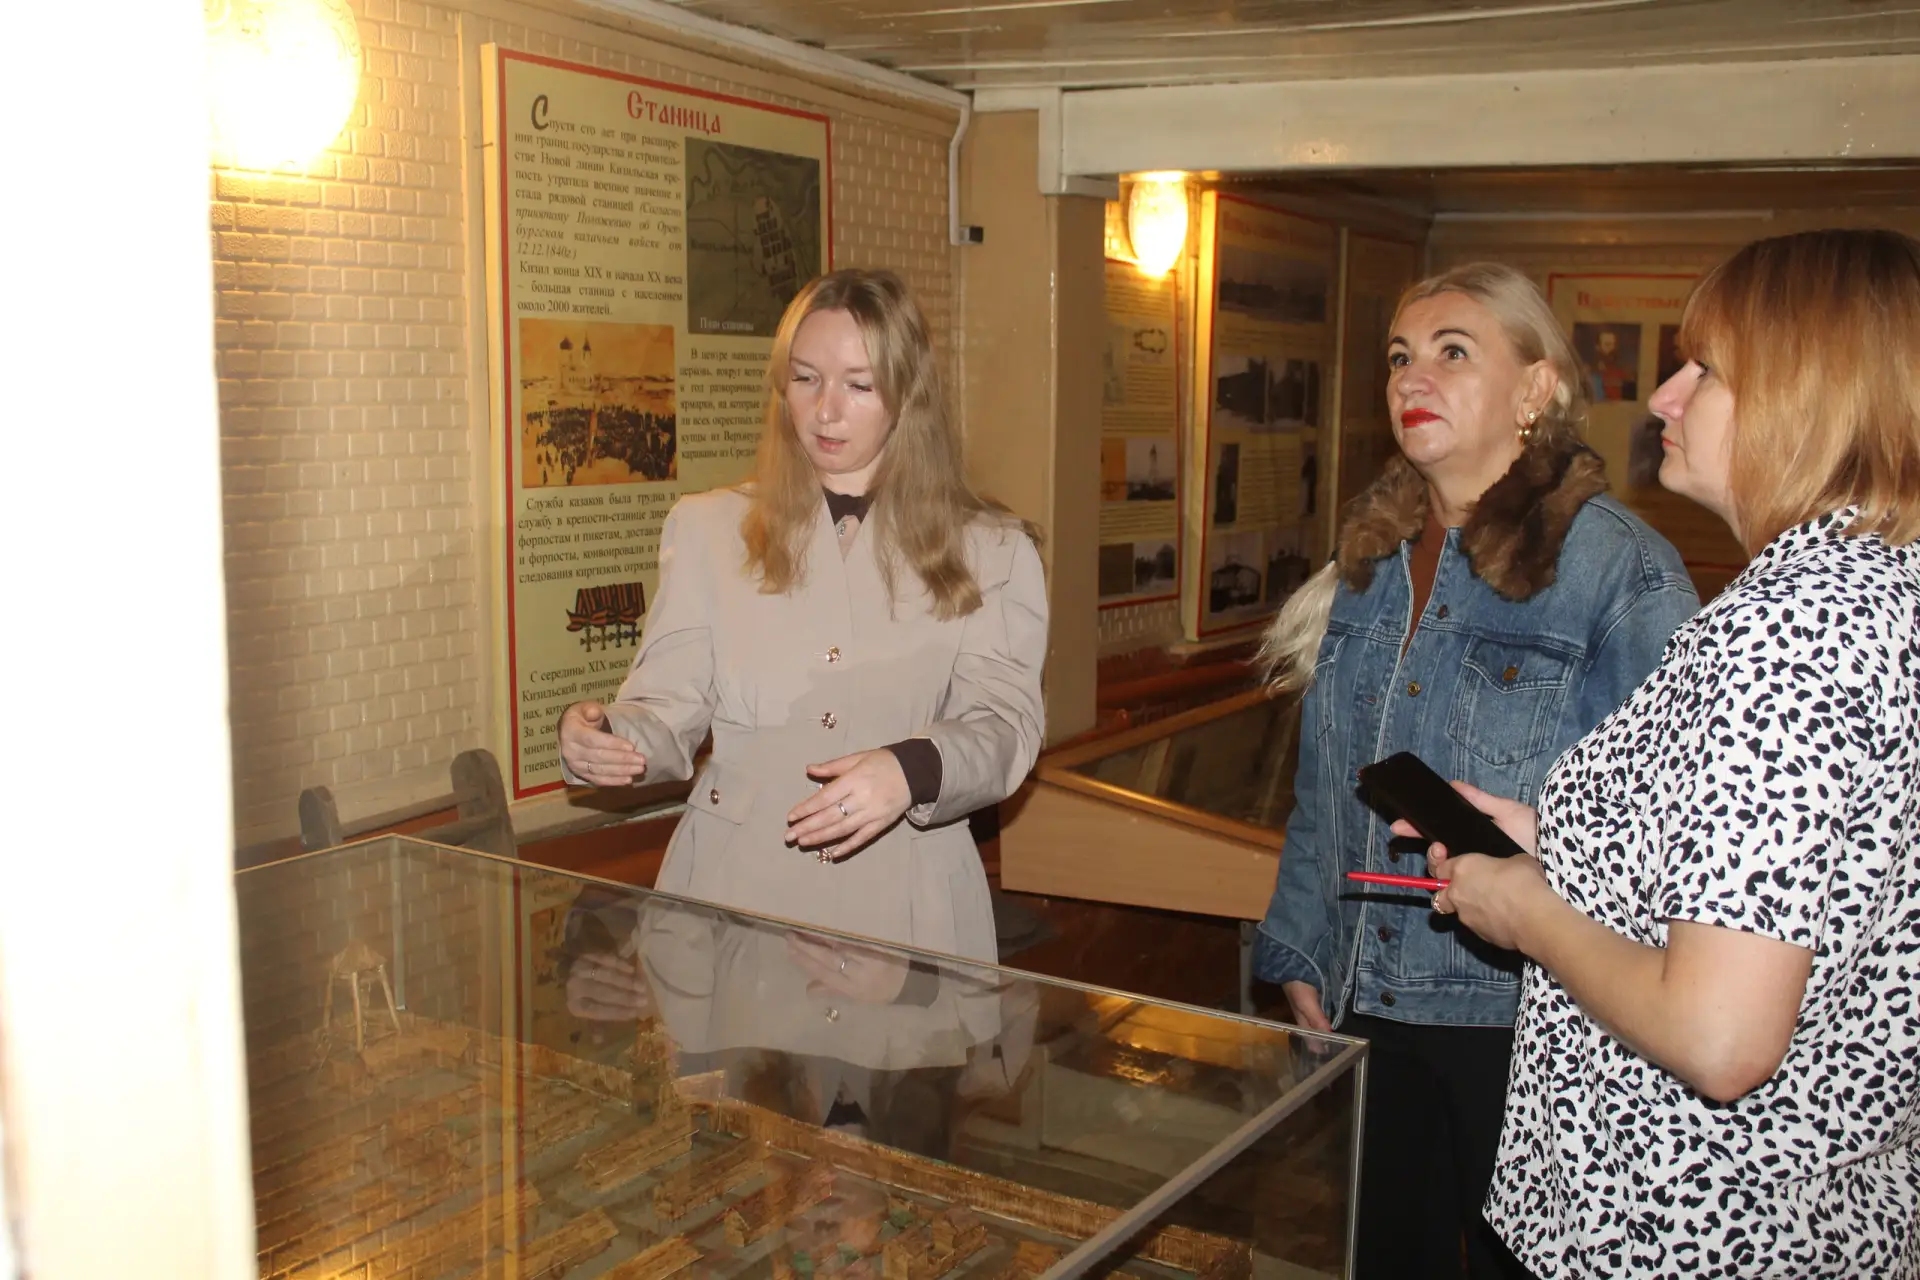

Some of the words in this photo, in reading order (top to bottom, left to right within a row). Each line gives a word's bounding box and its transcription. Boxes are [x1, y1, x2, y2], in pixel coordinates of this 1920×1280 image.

[627, 90, 721, 136] Станица
[514, 151, 535, 163] стве
[541, 151, 571, 168] Новой
[515, 170, 543, 182] пость
[547, 174, 589, 188] утратила
[593, 179, 629, 193] военное
[515, 188, 542, 201] стала
[548, 191, 586, 206] рядовой
[592, 198, 633, 212] станицей
[519, 260, 550, 275] Кизил
[553, 266, 580, 278] конца
[583, 265, 603, 279] XIX
[614, 270, 644, 282] начала
[647, 271, 662, 283] XX
[664, 274, 683, 285] века
[531, 280, 572, 295] большая
[578, 286, 615, 298] станица
[621, 290, 627, 299] с
[634, 290, 683, 302] населением
[517, 300, 546, 312] около
[547, 299, 570, 313] 2000
[526, 495, 564, 512] Служба
[569, 496, 604, 508] казаков
[608, 492, 631, 505] была
[637, 492, 666, 506] трудна
[518, 515, 552, 530] службу
[556, 516, 563, 526] в
[566, 510, 646, 528] крепости-станице
[518, 534, 571, 550] форпостам
[573, 533, 580, 543] и
[519, 555, 525, 565] и
[528, 550, 580, 567] форпосты,
[583, 545, 645, 560] конвоировали
[519, 568, 573, 584] следования
[624, 560, 659, 574] отрядов
[530, 670, 538, 683] С
[540, 665, 586, 682] середины
[588, 659, 607, 673] XIX
[609, 659, 629, 670] века
[521, 682, 578, 702] Кизильской
[523, 709, 542, 720] нах,
[523, 726, 534, 738] За
[523, 741, 558, 756] многие
